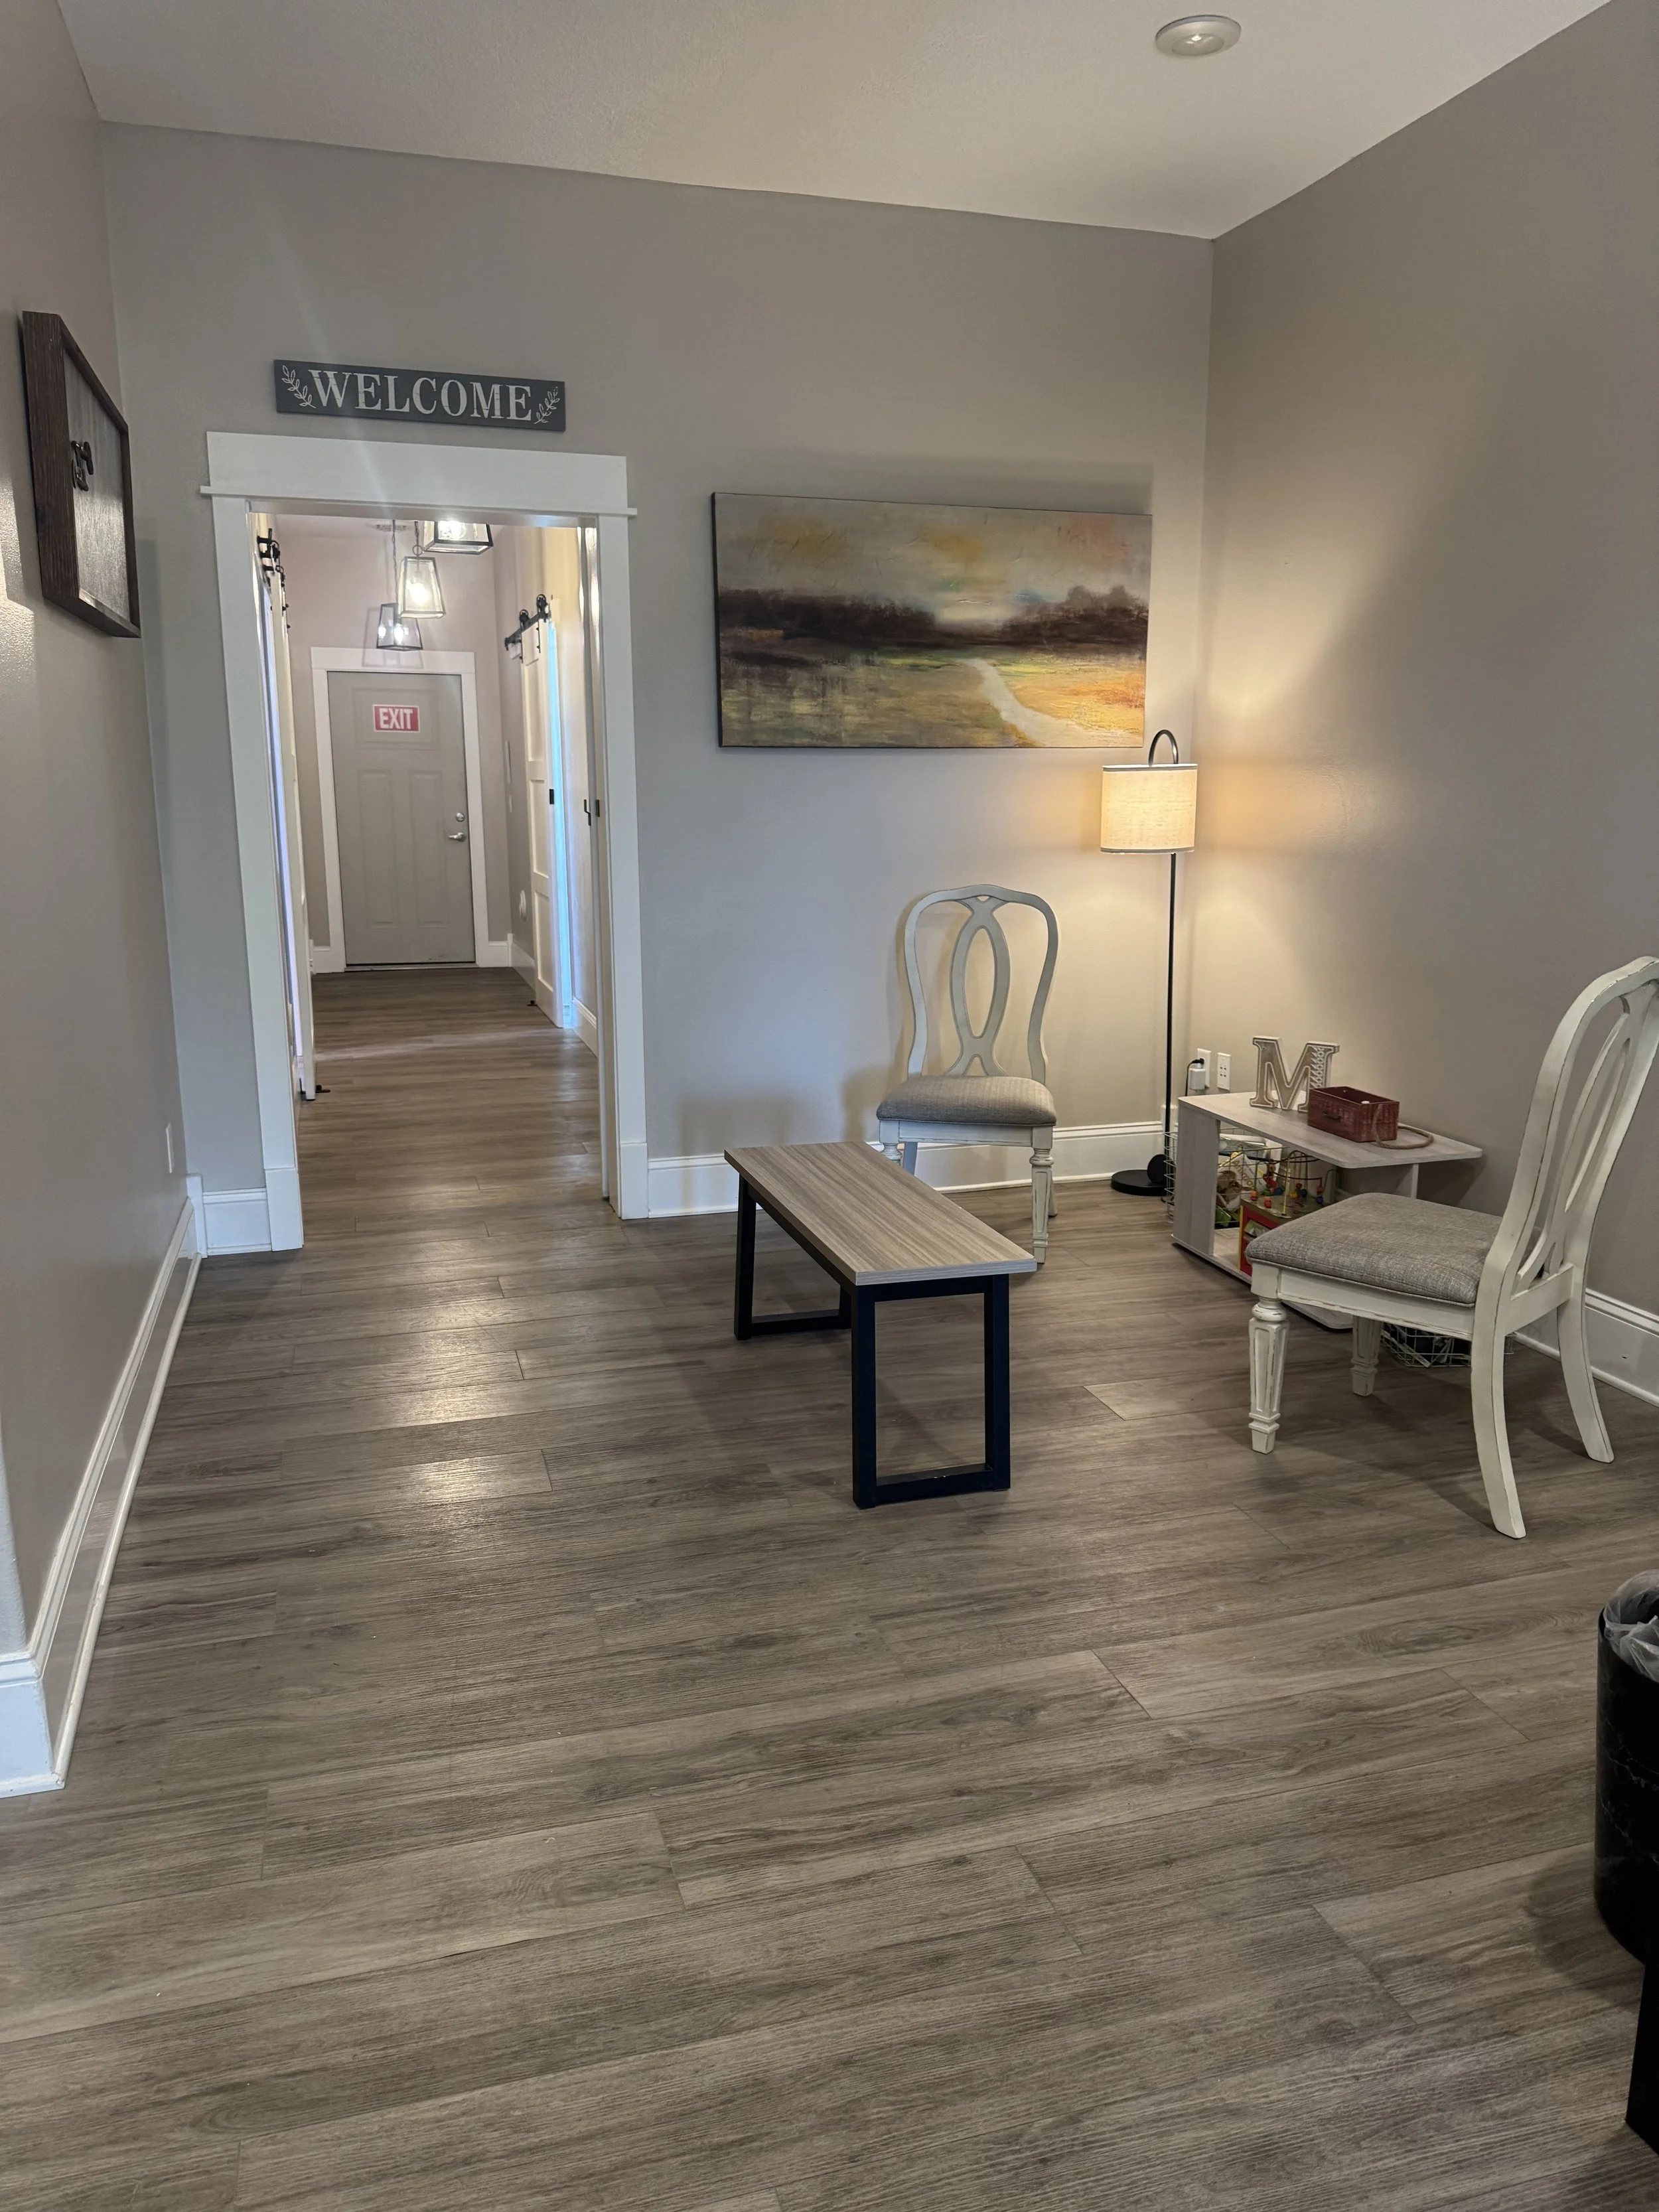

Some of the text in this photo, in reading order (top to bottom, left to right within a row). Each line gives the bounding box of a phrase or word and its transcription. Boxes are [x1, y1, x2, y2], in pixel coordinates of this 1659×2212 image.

[308, 369, 532, 421] WELCOME
[379, 707, 413, 729] EXIT
[1250, 1036, 1340, 1114] M
